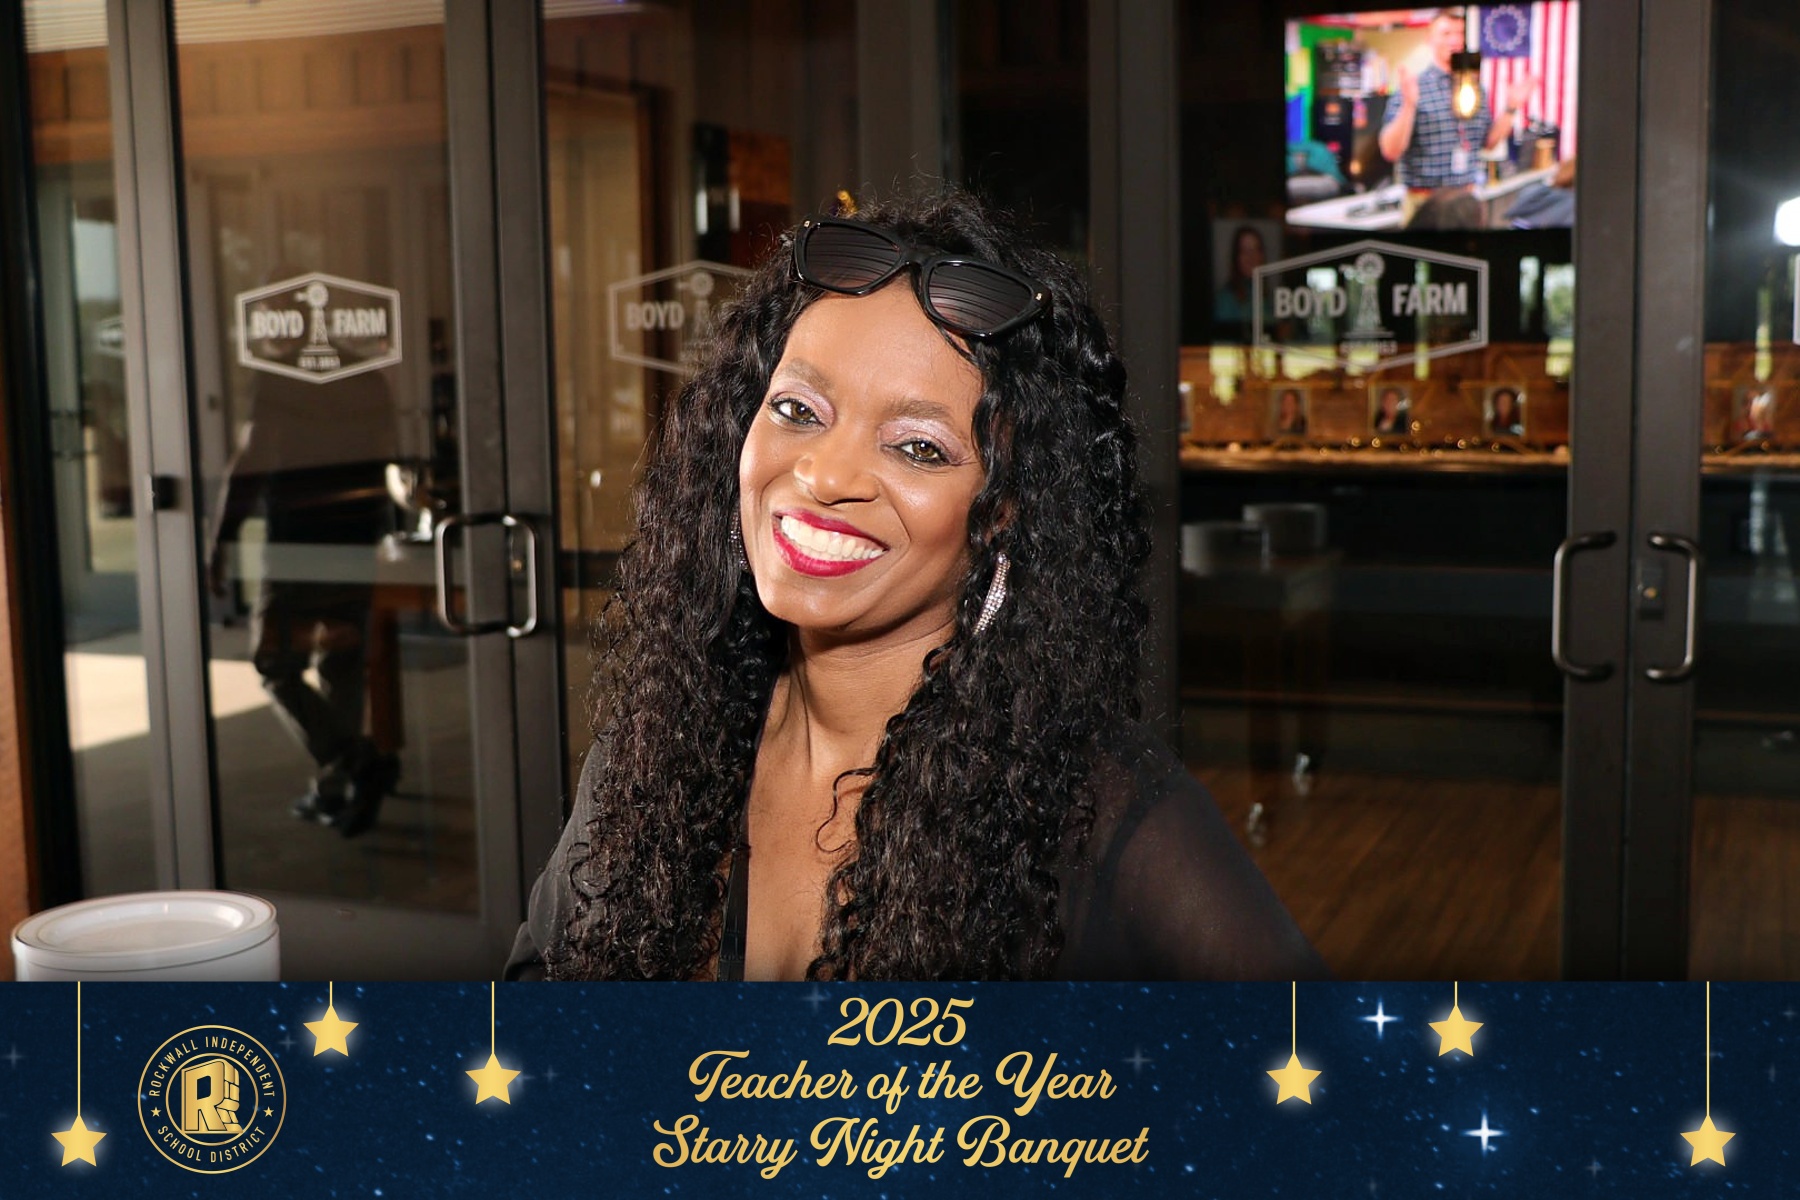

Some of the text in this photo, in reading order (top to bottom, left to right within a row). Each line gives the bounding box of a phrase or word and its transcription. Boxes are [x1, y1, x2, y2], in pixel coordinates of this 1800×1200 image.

[625, 300, 685, 331] BOYD
[1274, 283, 1468, 318] BOYD FARM
[250, 307, 387, 339] BOYD FARM
